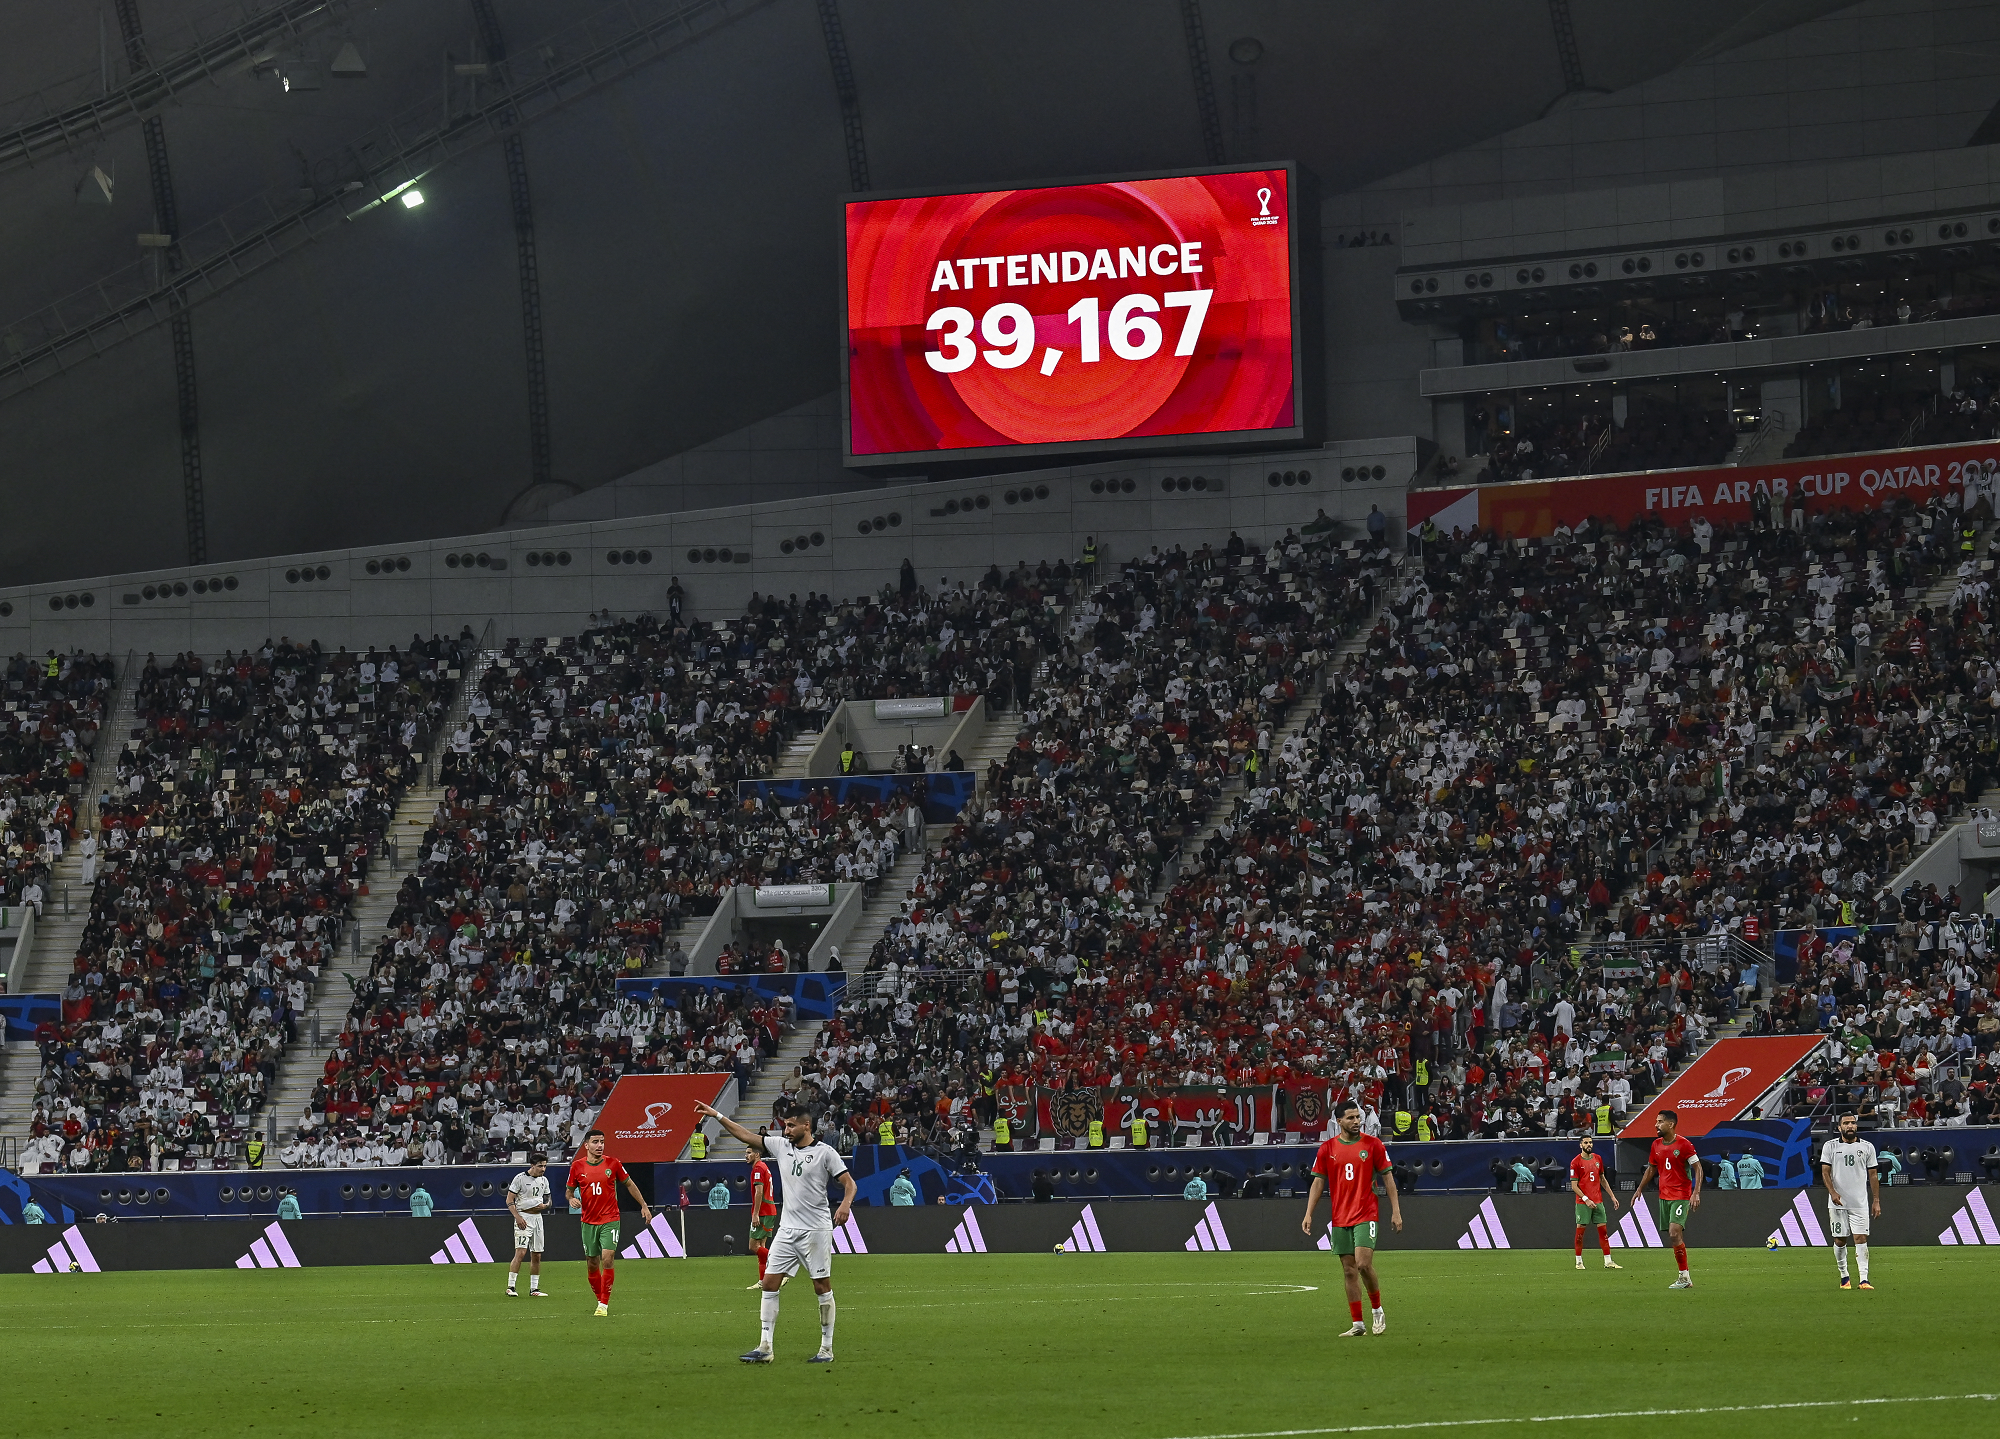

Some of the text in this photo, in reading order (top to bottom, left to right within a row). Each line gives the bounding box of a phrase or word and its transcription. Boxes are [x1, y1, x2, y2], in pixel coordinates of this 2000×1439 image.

[930, 241, 1203, 292] ATTENDANCE
[924, 289, 1214, 377] 39,167
[1645, 485, 1704, 510] FIFA
[1713, 478, 1789, 505] ARAB
[1799, 472, 1850, 497] CUP
[1859, 464, 1941, 498] QATAR
[1665, 1157, 1672, 1171] 6
[1843, 1154, 1856, 1167] 18
[791, 1160, 804, 1177] 16
[1344, 1163, 1355, 1181] 8
[1589, 1171, 1595, 1182] 5
[532, 1186, 540, 1197] 12
[590, 1181, 603, 1196] 16
[1675, 1204, 1683, 1216] 6
[610, 1228, 620, 1243] 16
[1369, 1220, 1376, 1238] 8
[1831, 1222, 1842, 1234] 18
[518, 1235, 527, 1246] 12
